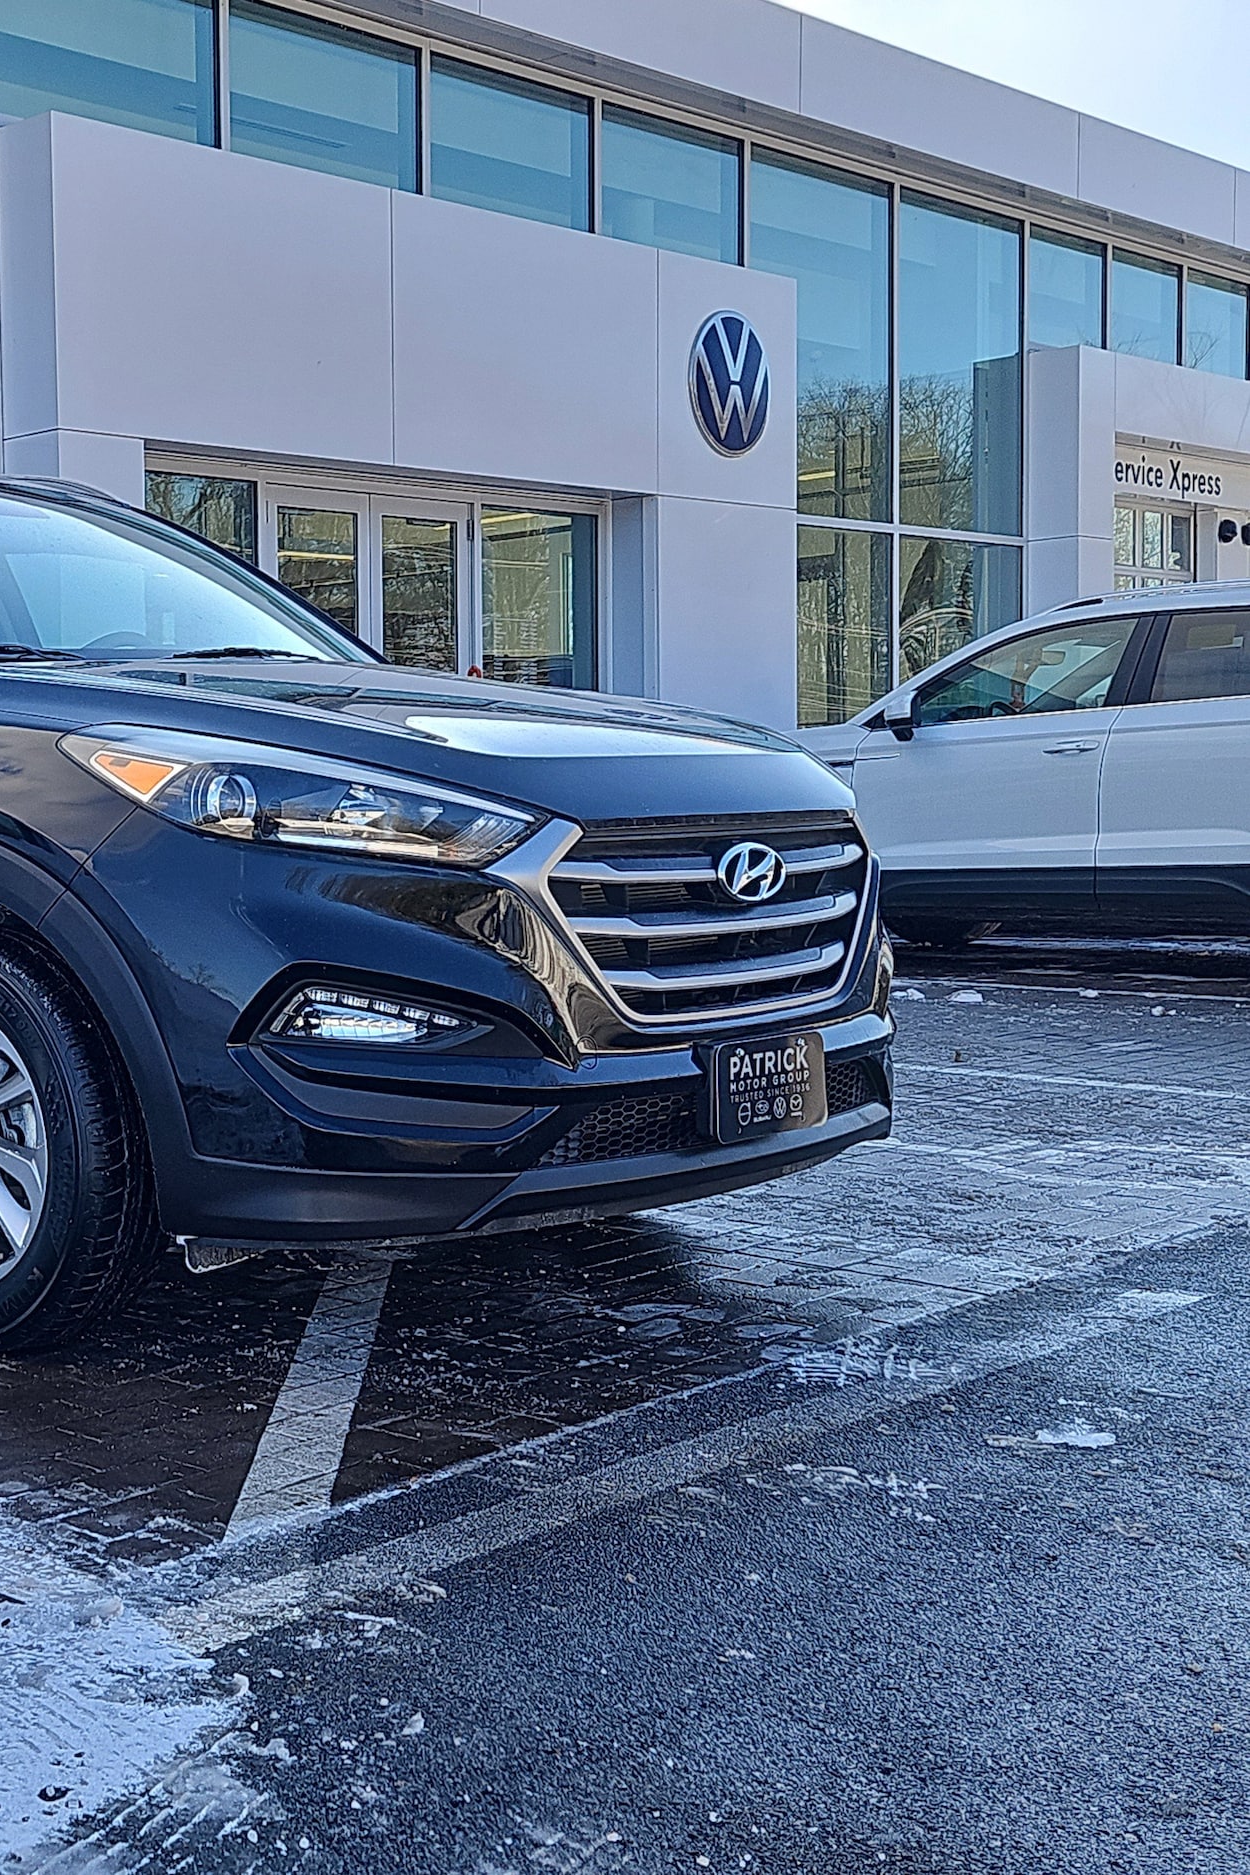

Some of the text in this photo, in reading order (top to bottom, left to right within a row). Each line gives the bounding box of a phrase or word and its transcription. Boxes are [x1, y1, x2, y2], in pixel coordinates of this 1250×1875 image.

[1168, 458, 1222, 499] Xpress
[729, 1045, 810, 1081] PATRICK
[729, 1070, 810, 1094] MOTOR GROUP
[730, 1090, 765, 1104] TRUSTED
[766, 1085, 791, 1098] SINCE
